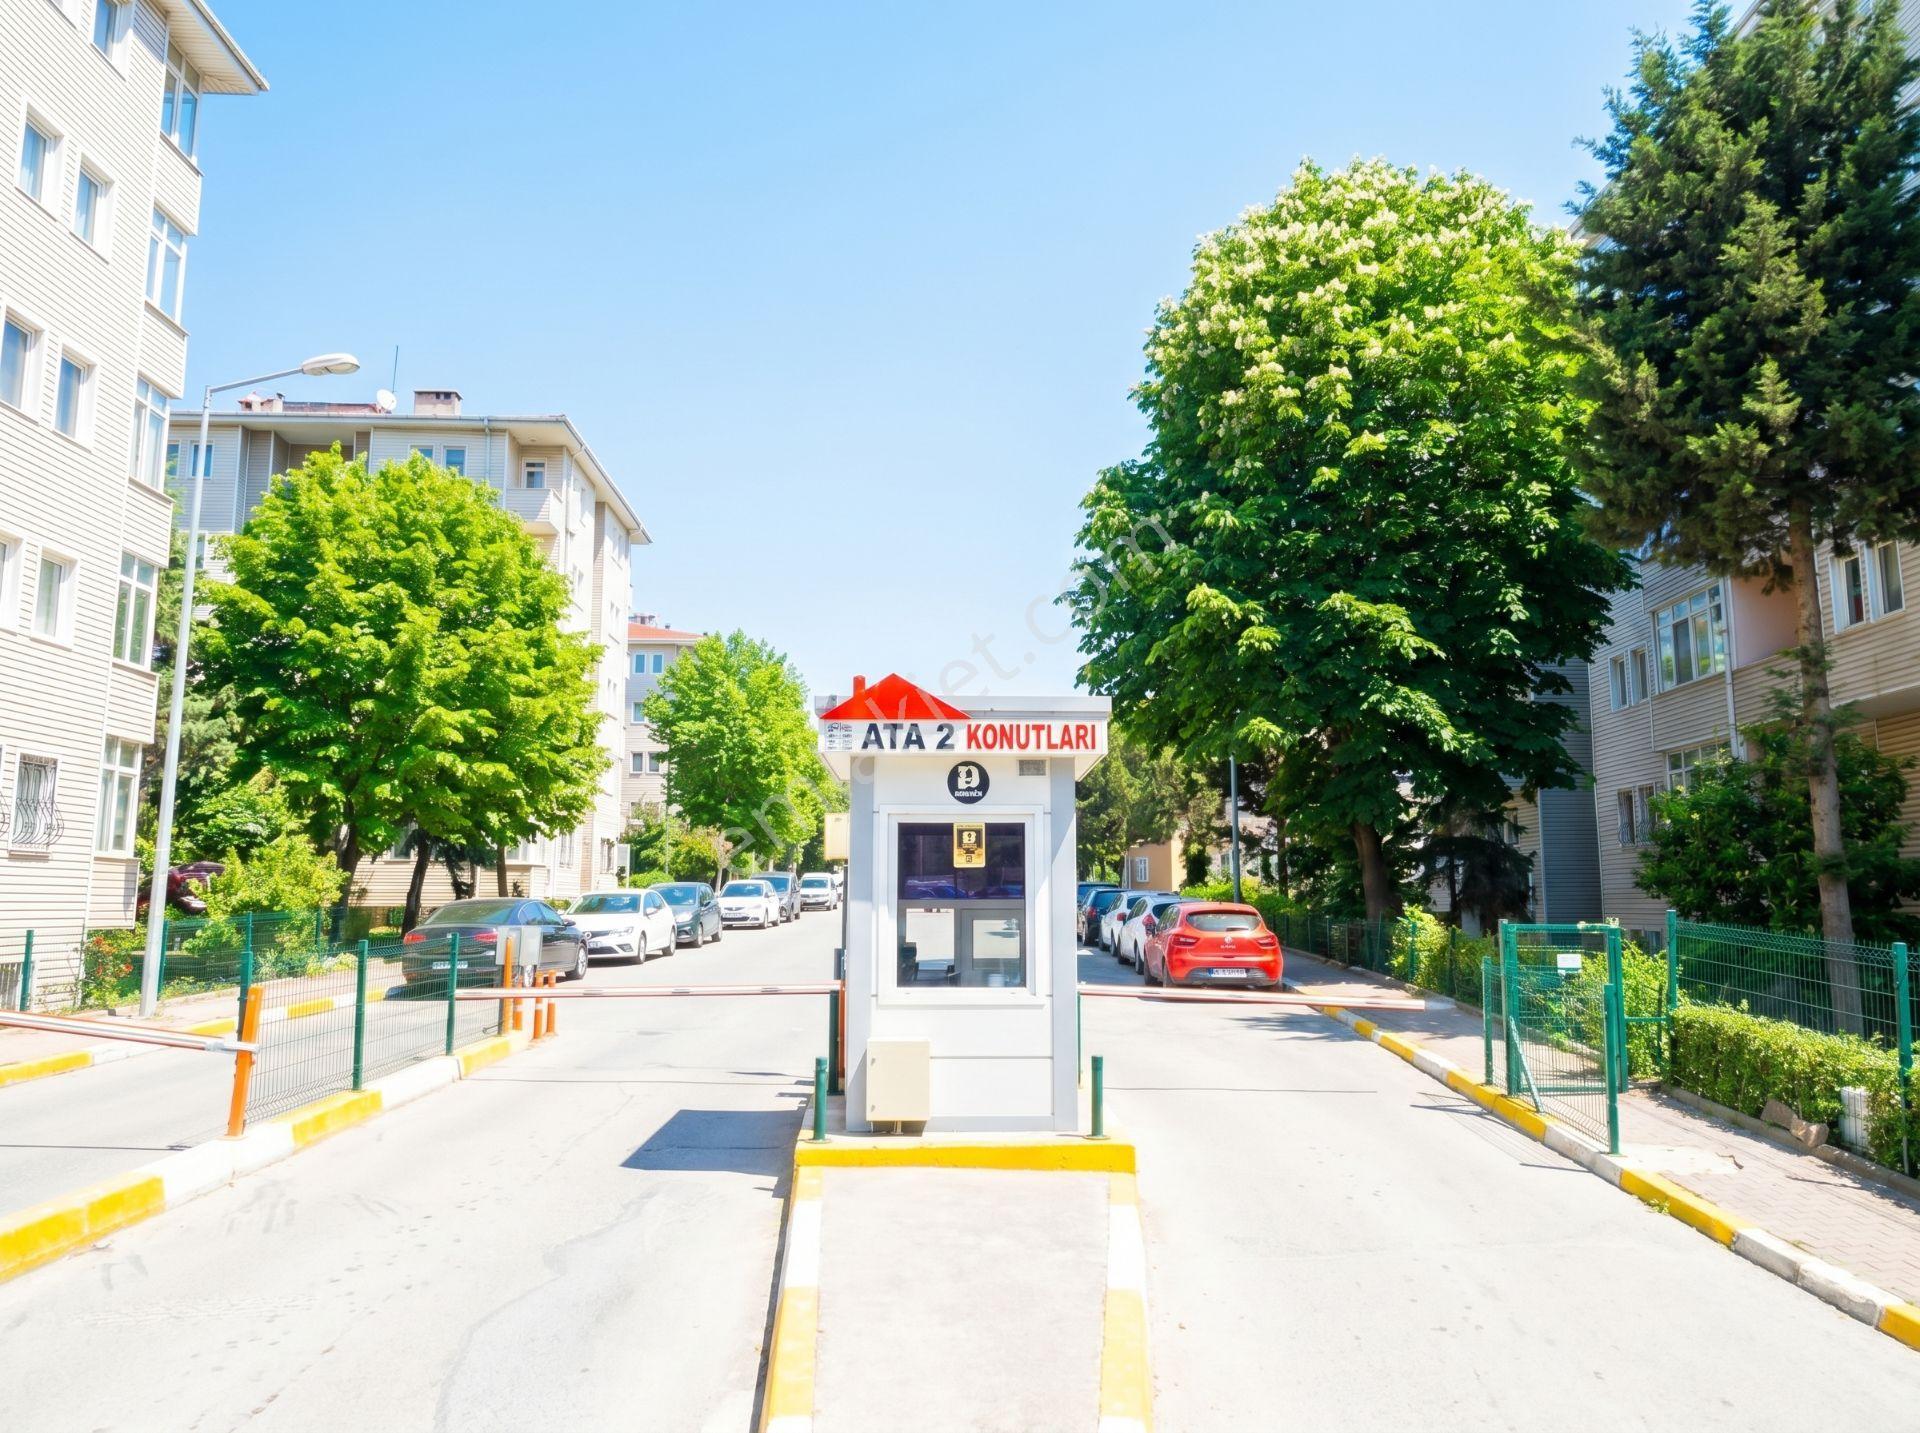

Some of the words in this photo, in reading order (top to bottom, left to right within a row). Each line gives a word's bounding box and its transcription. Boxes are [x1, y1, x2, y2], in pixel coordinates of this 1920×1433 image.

[861, 722, 926, 750] ATA
[936, 722, 955, 750] 2
[966, 723, 1096, 750] KONUTLARI
